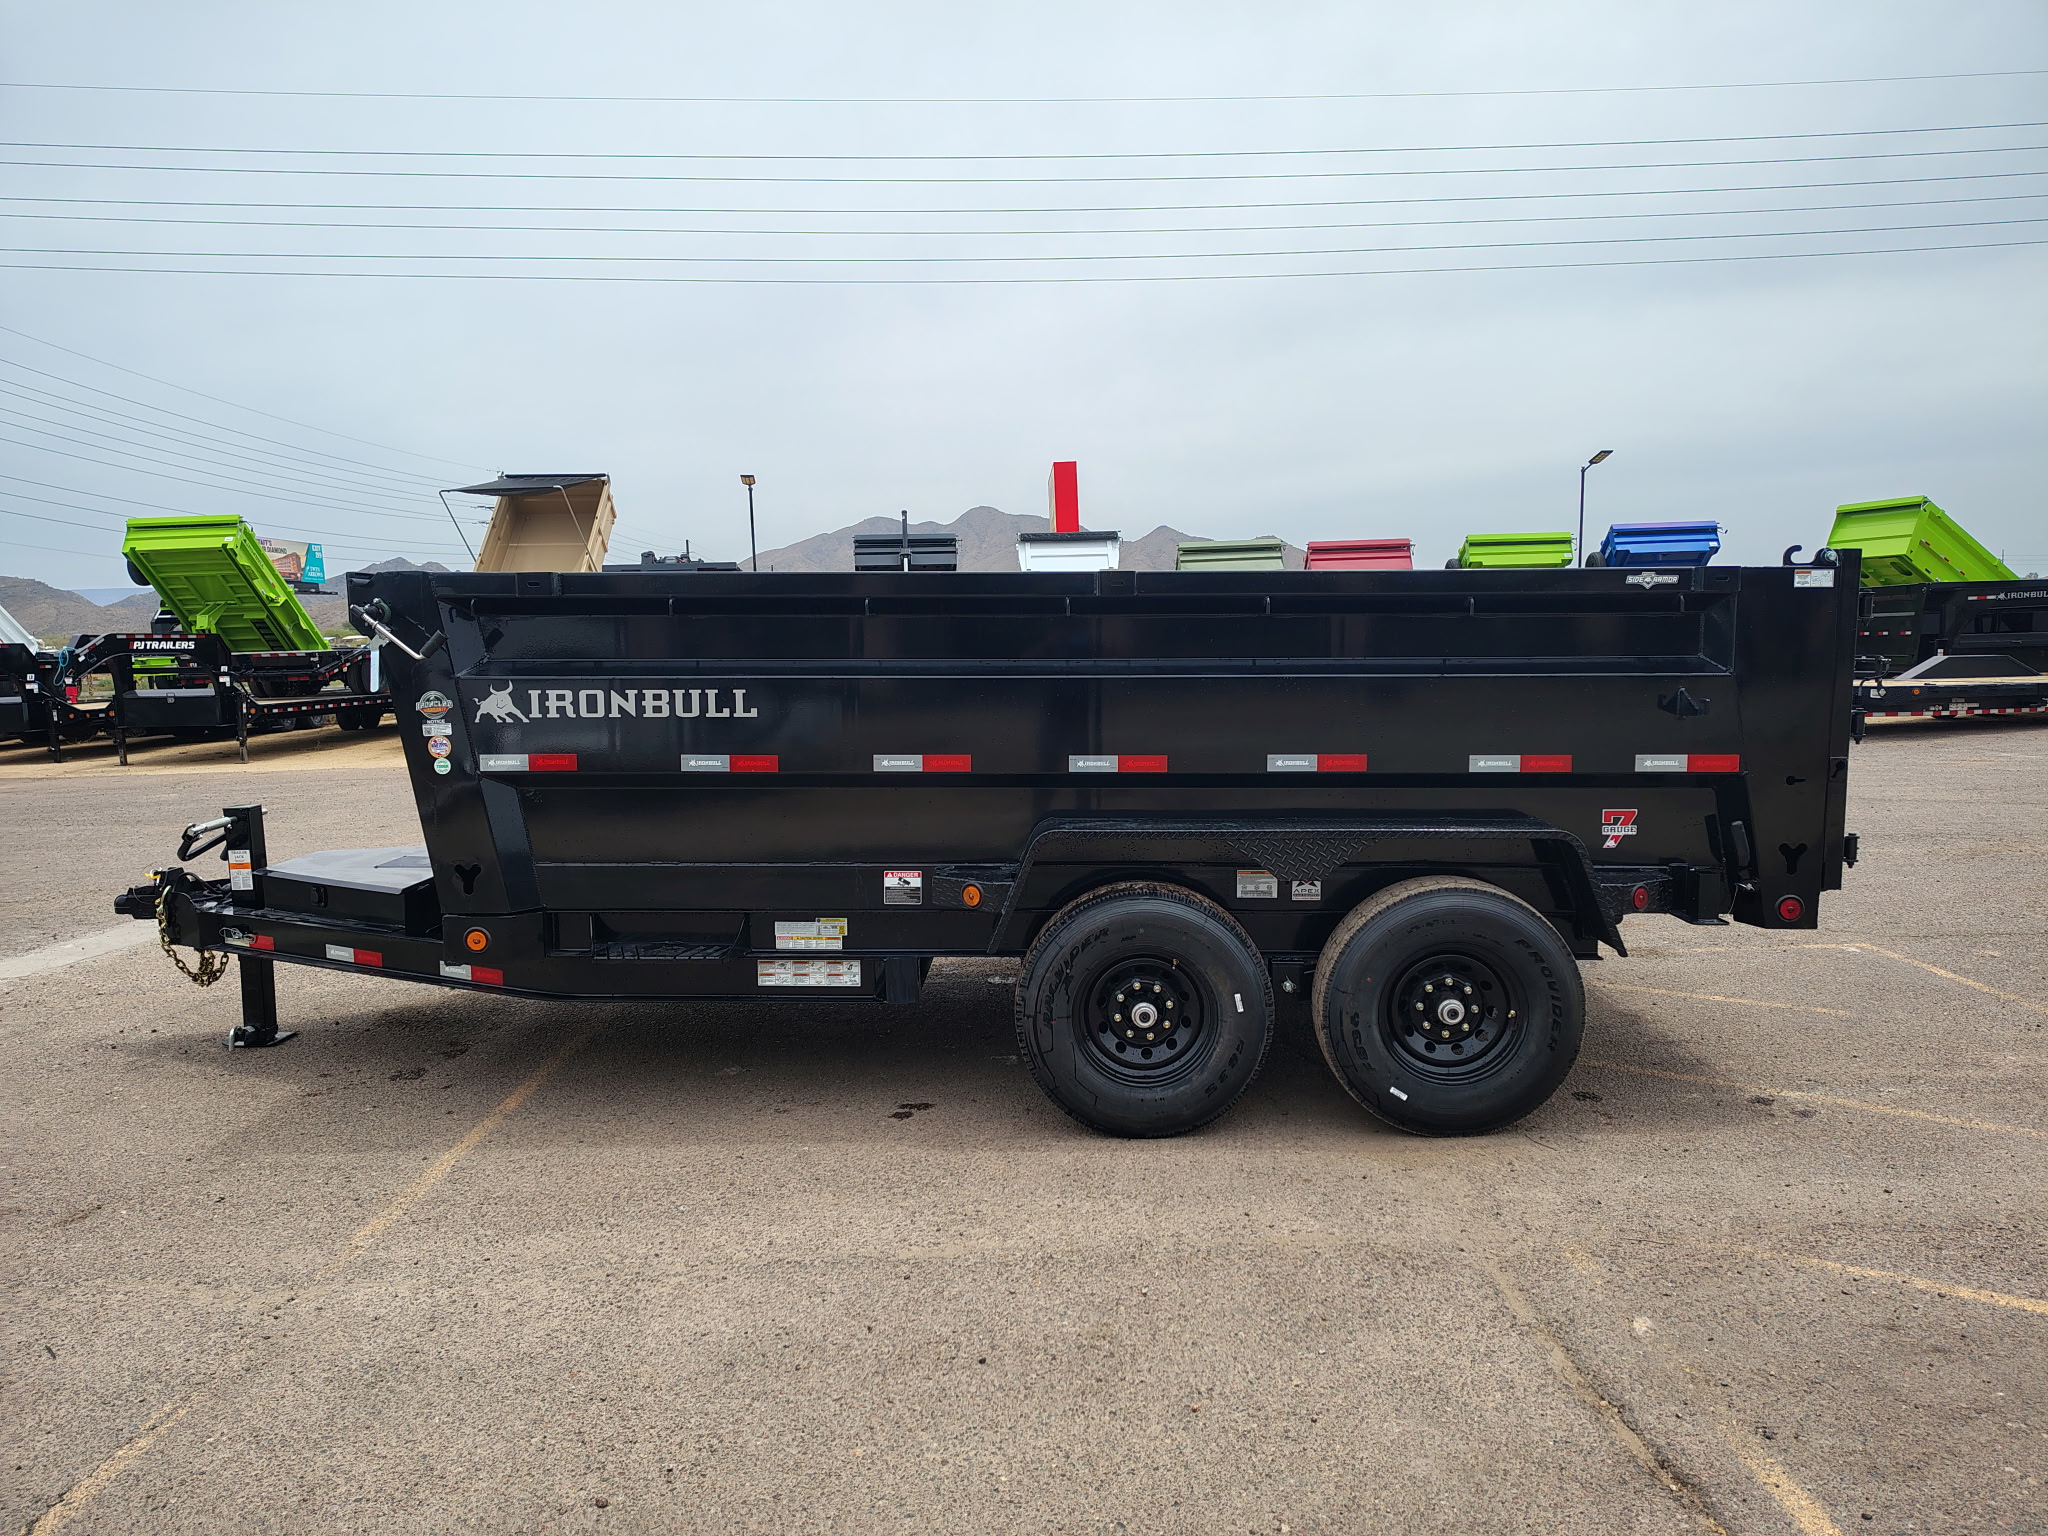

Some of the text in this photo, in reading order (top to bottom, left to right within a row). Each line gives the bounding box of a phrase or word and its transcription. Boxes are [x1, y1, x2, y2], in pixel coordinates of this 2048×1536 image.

[268, 546, 287, 554] DIAMOND
[133, 641, 195, 649] PJ TRAILERS
[528, 689, 758, 718] IRONBULL
[1602, 809, 1638, 848] 7
[1514, 938, 1562, 1052] PROVIDER
